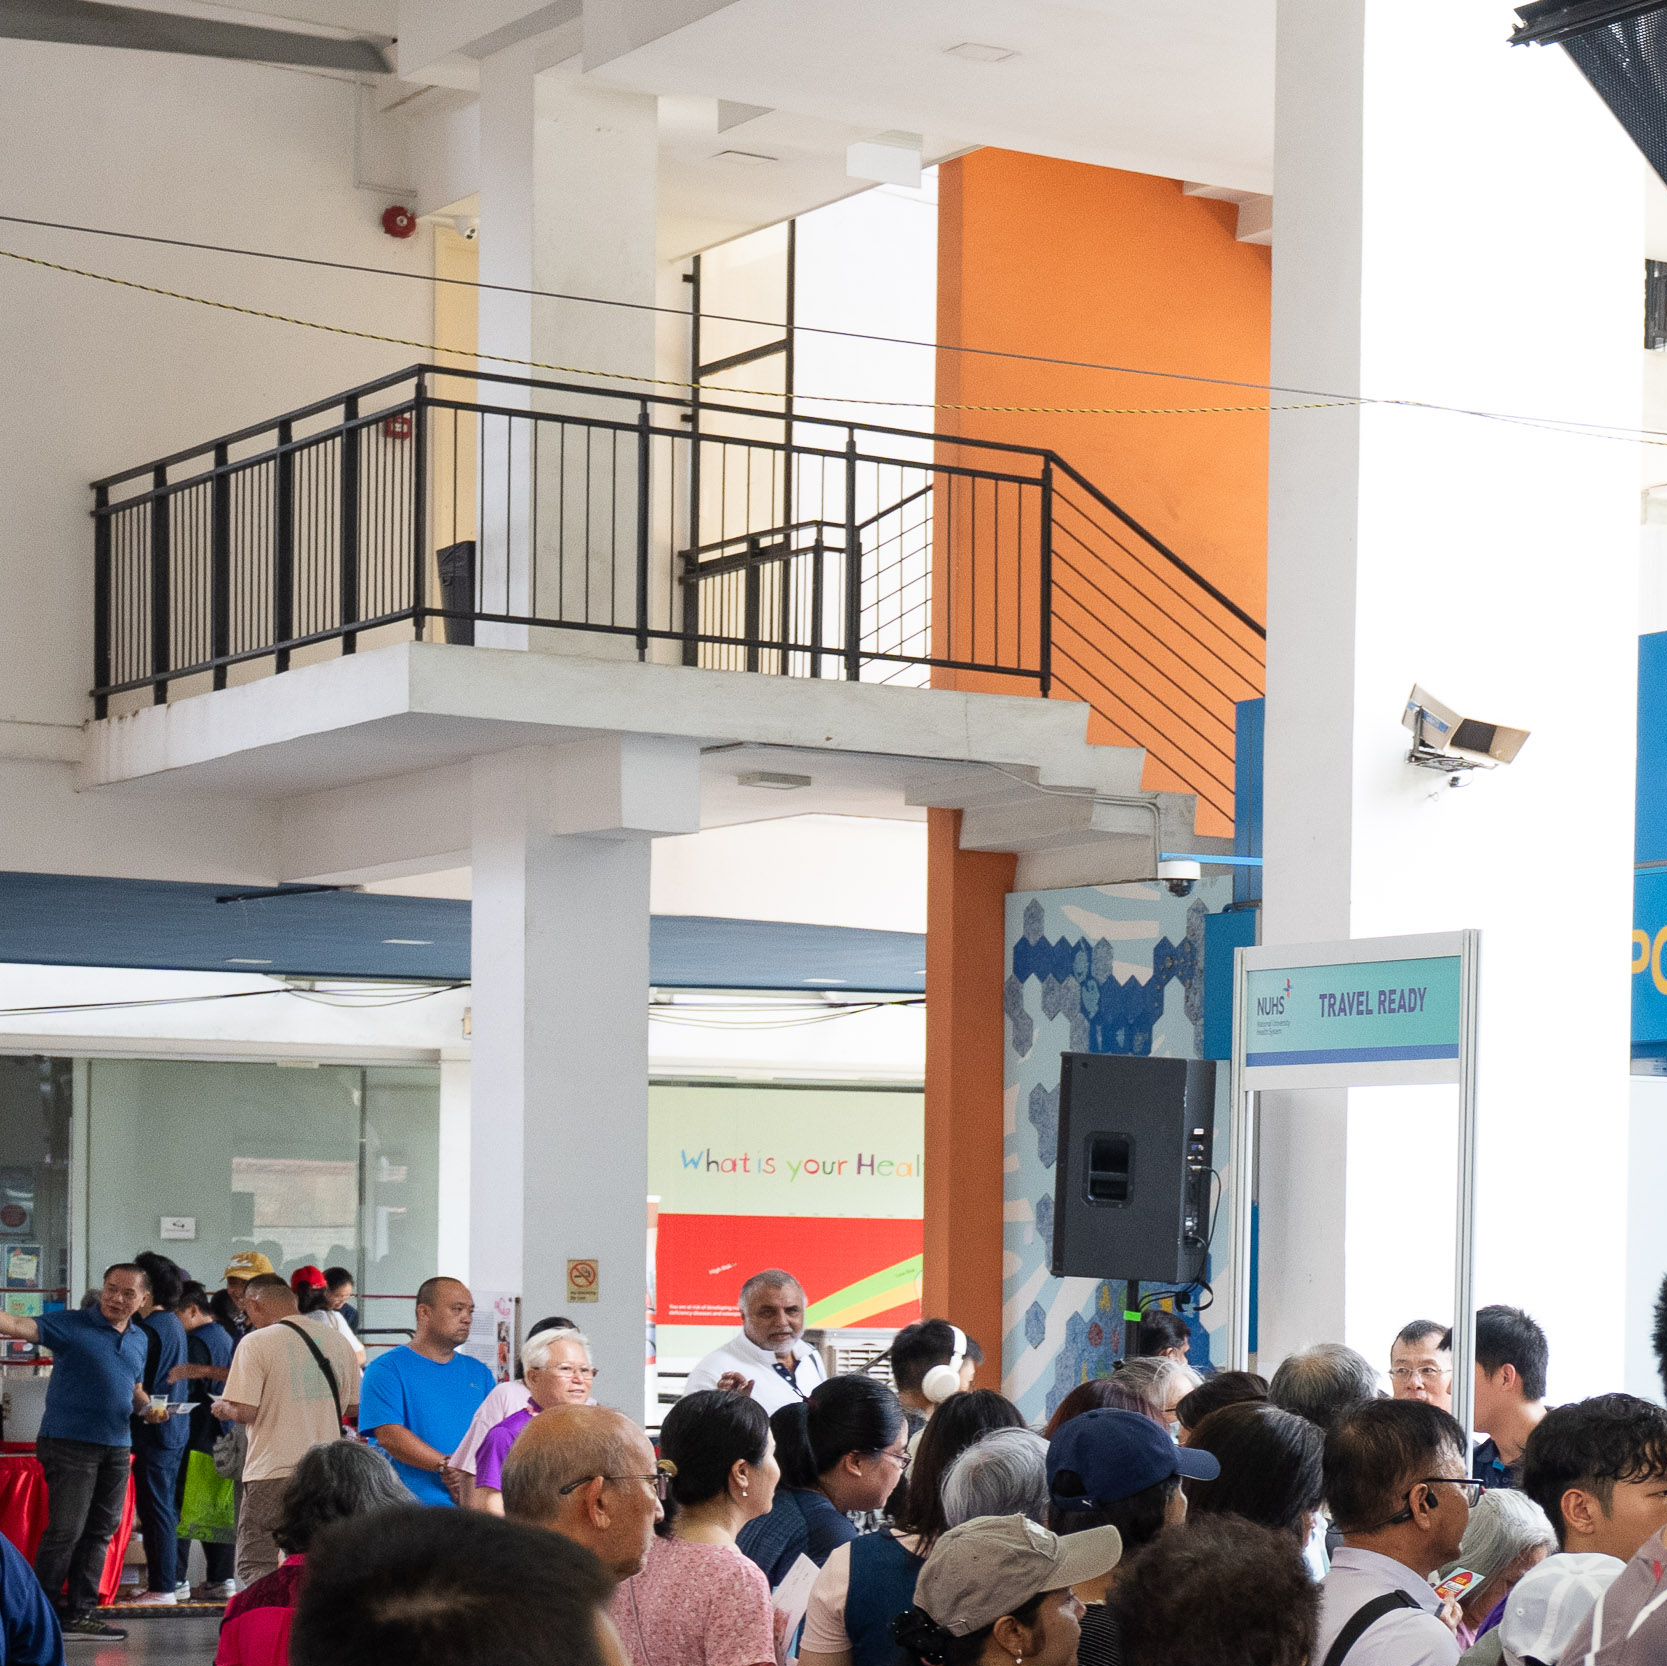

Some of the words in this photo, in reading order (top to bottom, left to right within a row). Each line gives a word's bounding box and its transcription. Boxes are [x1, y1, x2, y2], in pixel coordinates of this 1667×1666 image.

[1257, 995, 1285, 1016] NUHS
[1319, 990, 1373, 1018] TRAVEL
[1377, 987, 1428, 1014] READY
[681, 1148, 751, 1174] What
[757, 1157, 776, 1174] is
[786, 1158, 848, 1183] your
[856, 1153, 920, 1178] Heal
